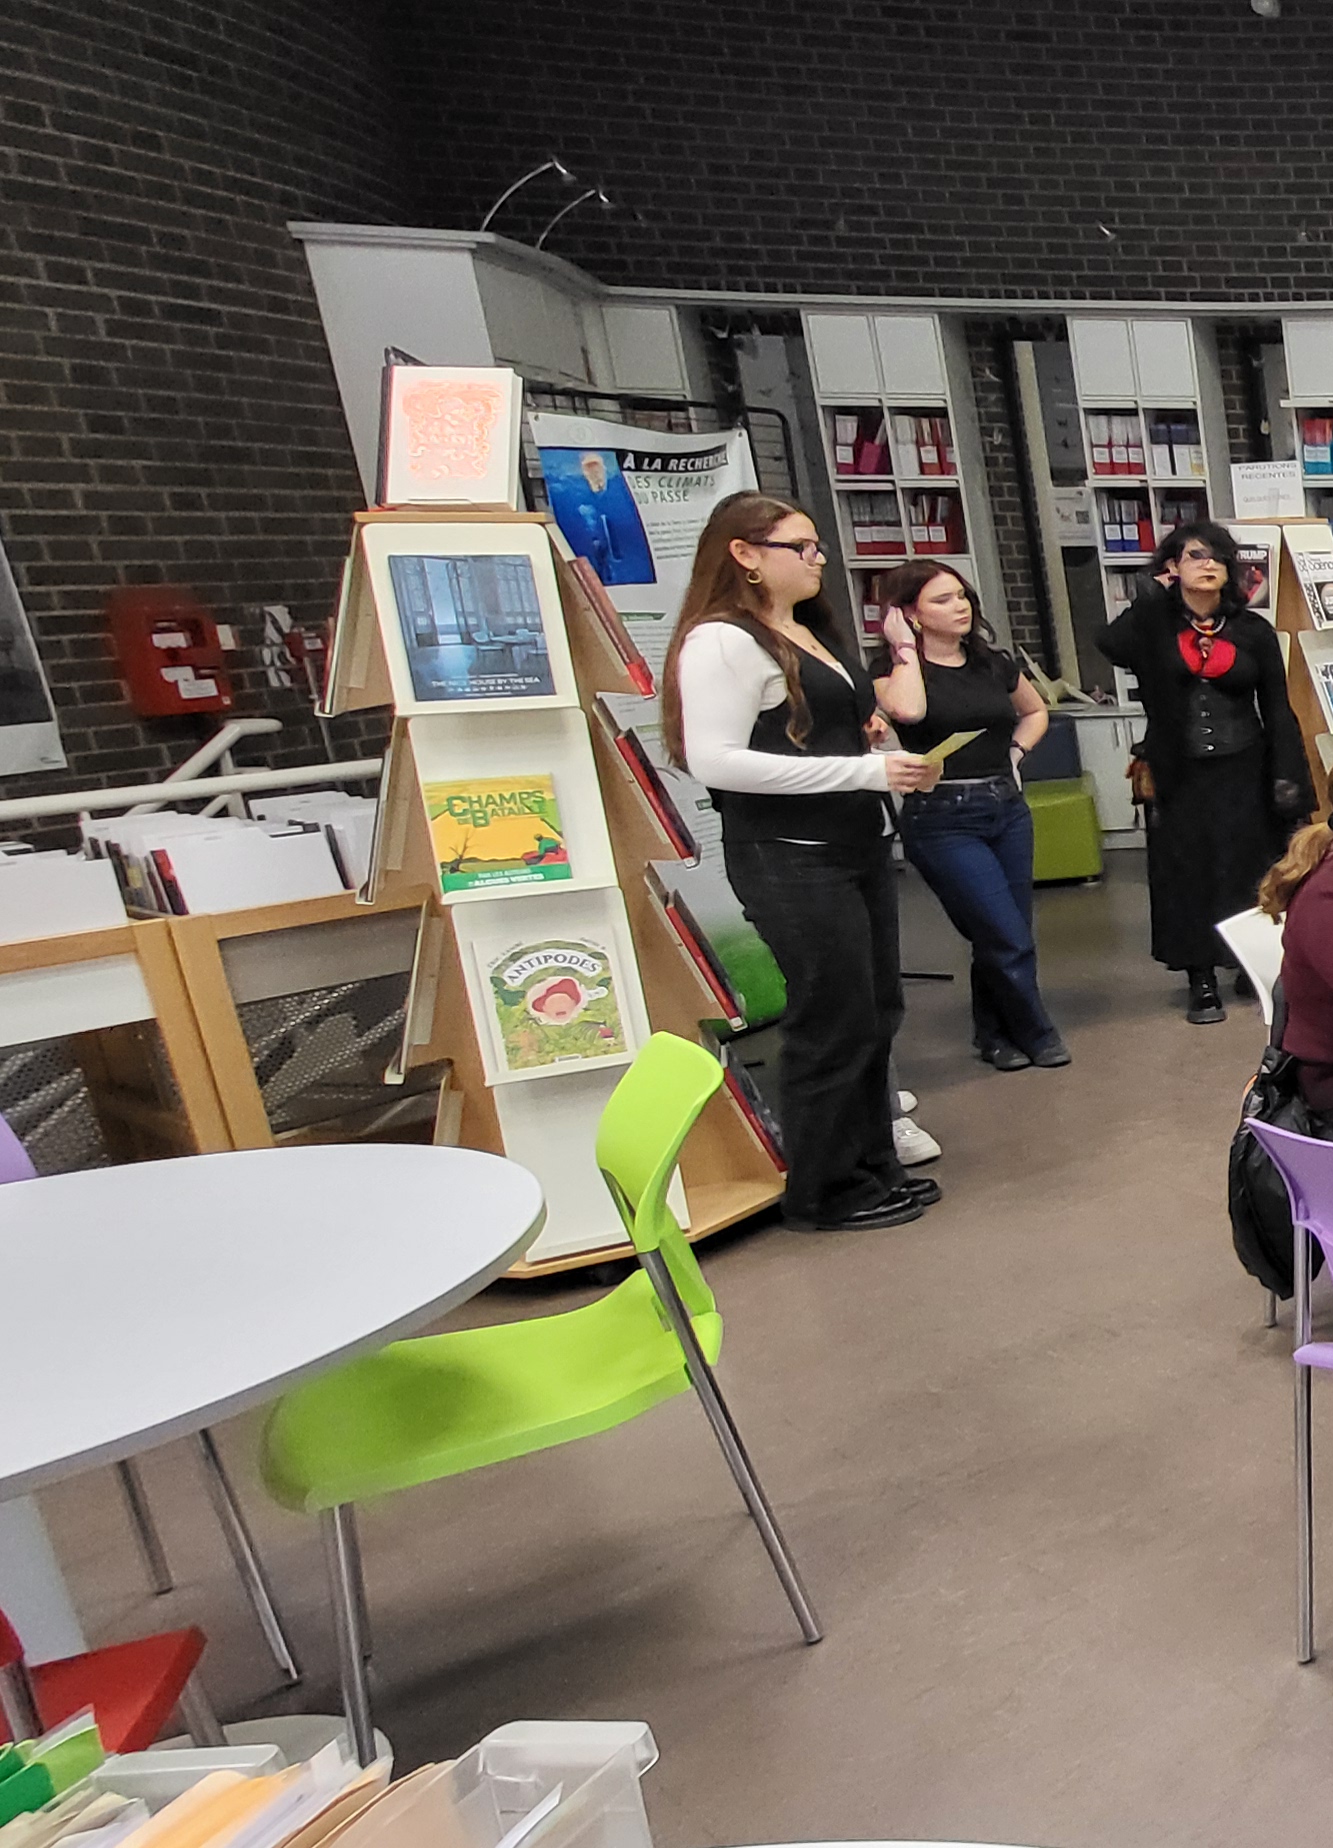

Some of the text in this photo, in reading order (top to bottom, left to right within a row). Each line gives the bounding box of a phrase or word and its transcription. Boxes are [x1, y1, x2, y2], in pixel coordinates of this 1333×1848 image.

[623, 452, 636, 470] À
[642, 458, 662, 471] LA
[658, 475, 716, 489] CLIMATS
[447, 790, 545, 817] CHAMPS
[507, 953, 599, 983] ANTIPODES
